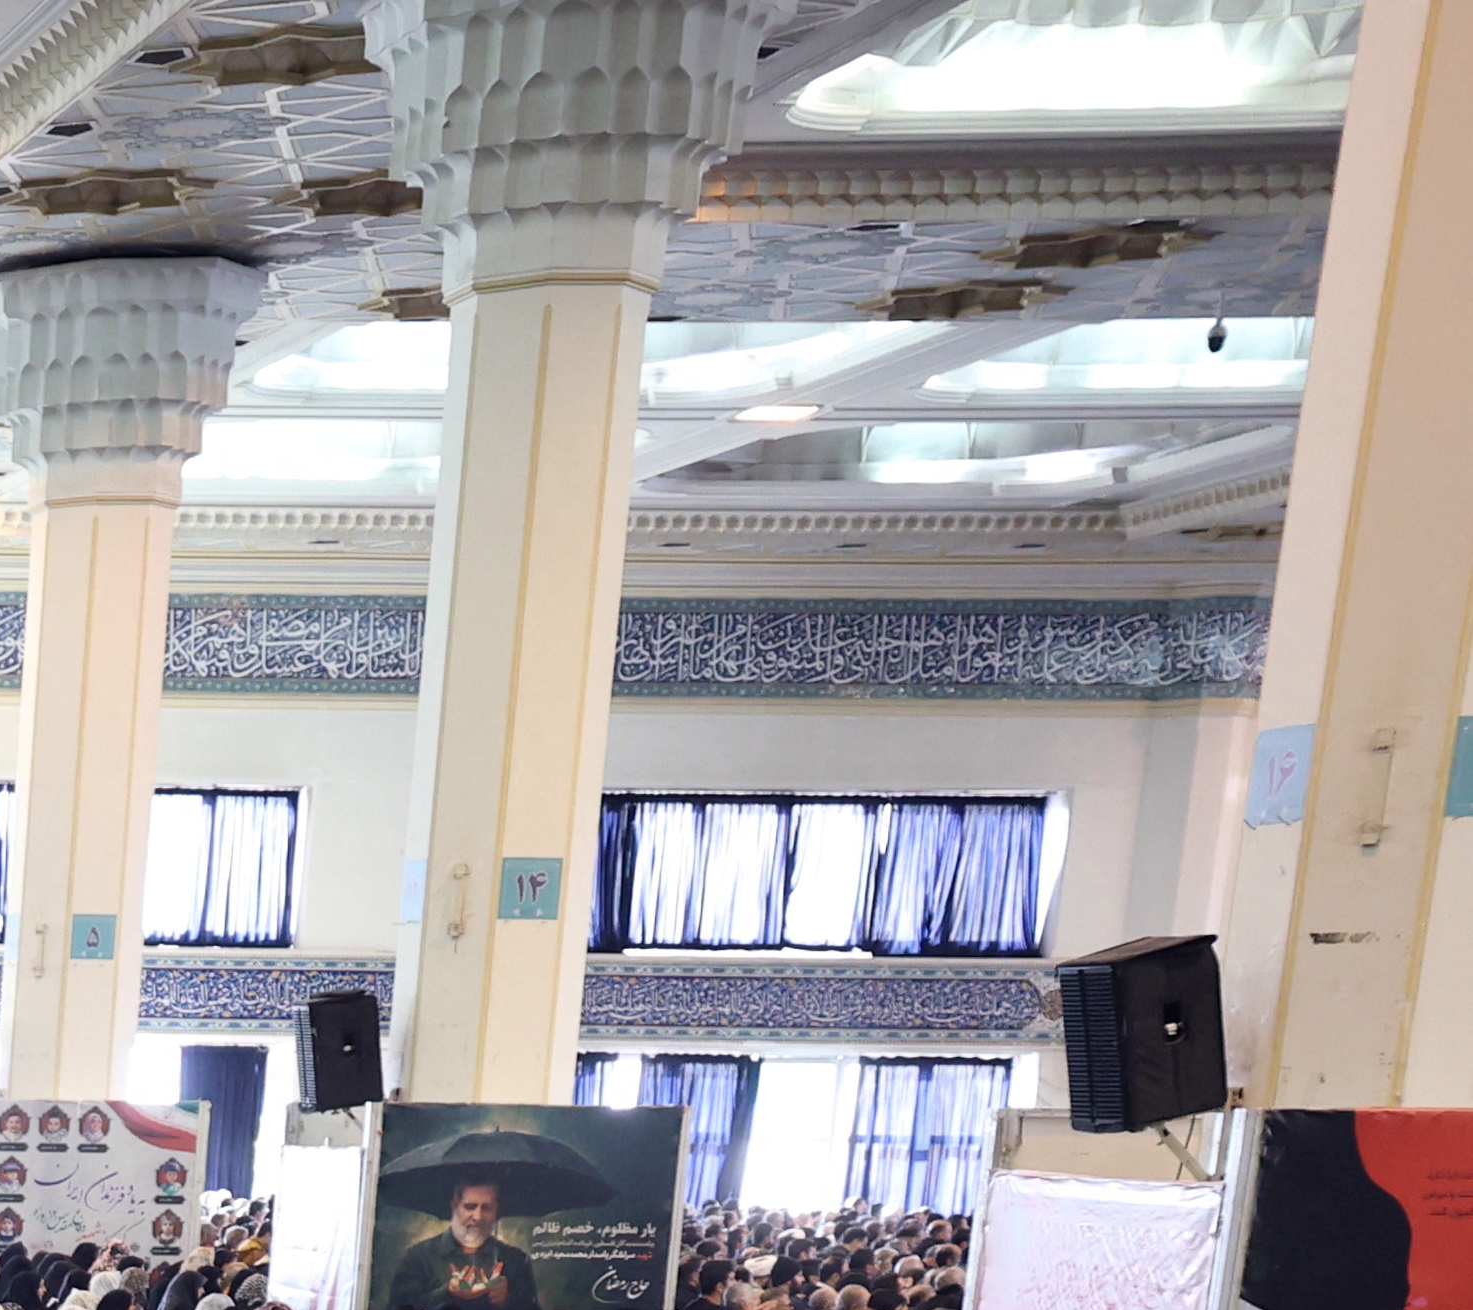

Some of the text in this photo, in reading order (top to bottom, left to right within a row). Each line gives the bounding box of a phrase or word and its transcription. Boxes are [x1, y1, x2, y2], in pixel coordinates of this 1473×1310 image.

[1267, 750, 1297, 796] ۱۶
[516, 871, 548, 904] ۱۴
[85, 924, 101, 948] ۵
[532, 1221, 562, 1236] ظالم
[562, 1220, 595, 1237] خصم
[640, 1221, 657, 1239] یار
[591, 1265, 651, 1304] حاج رمضان
